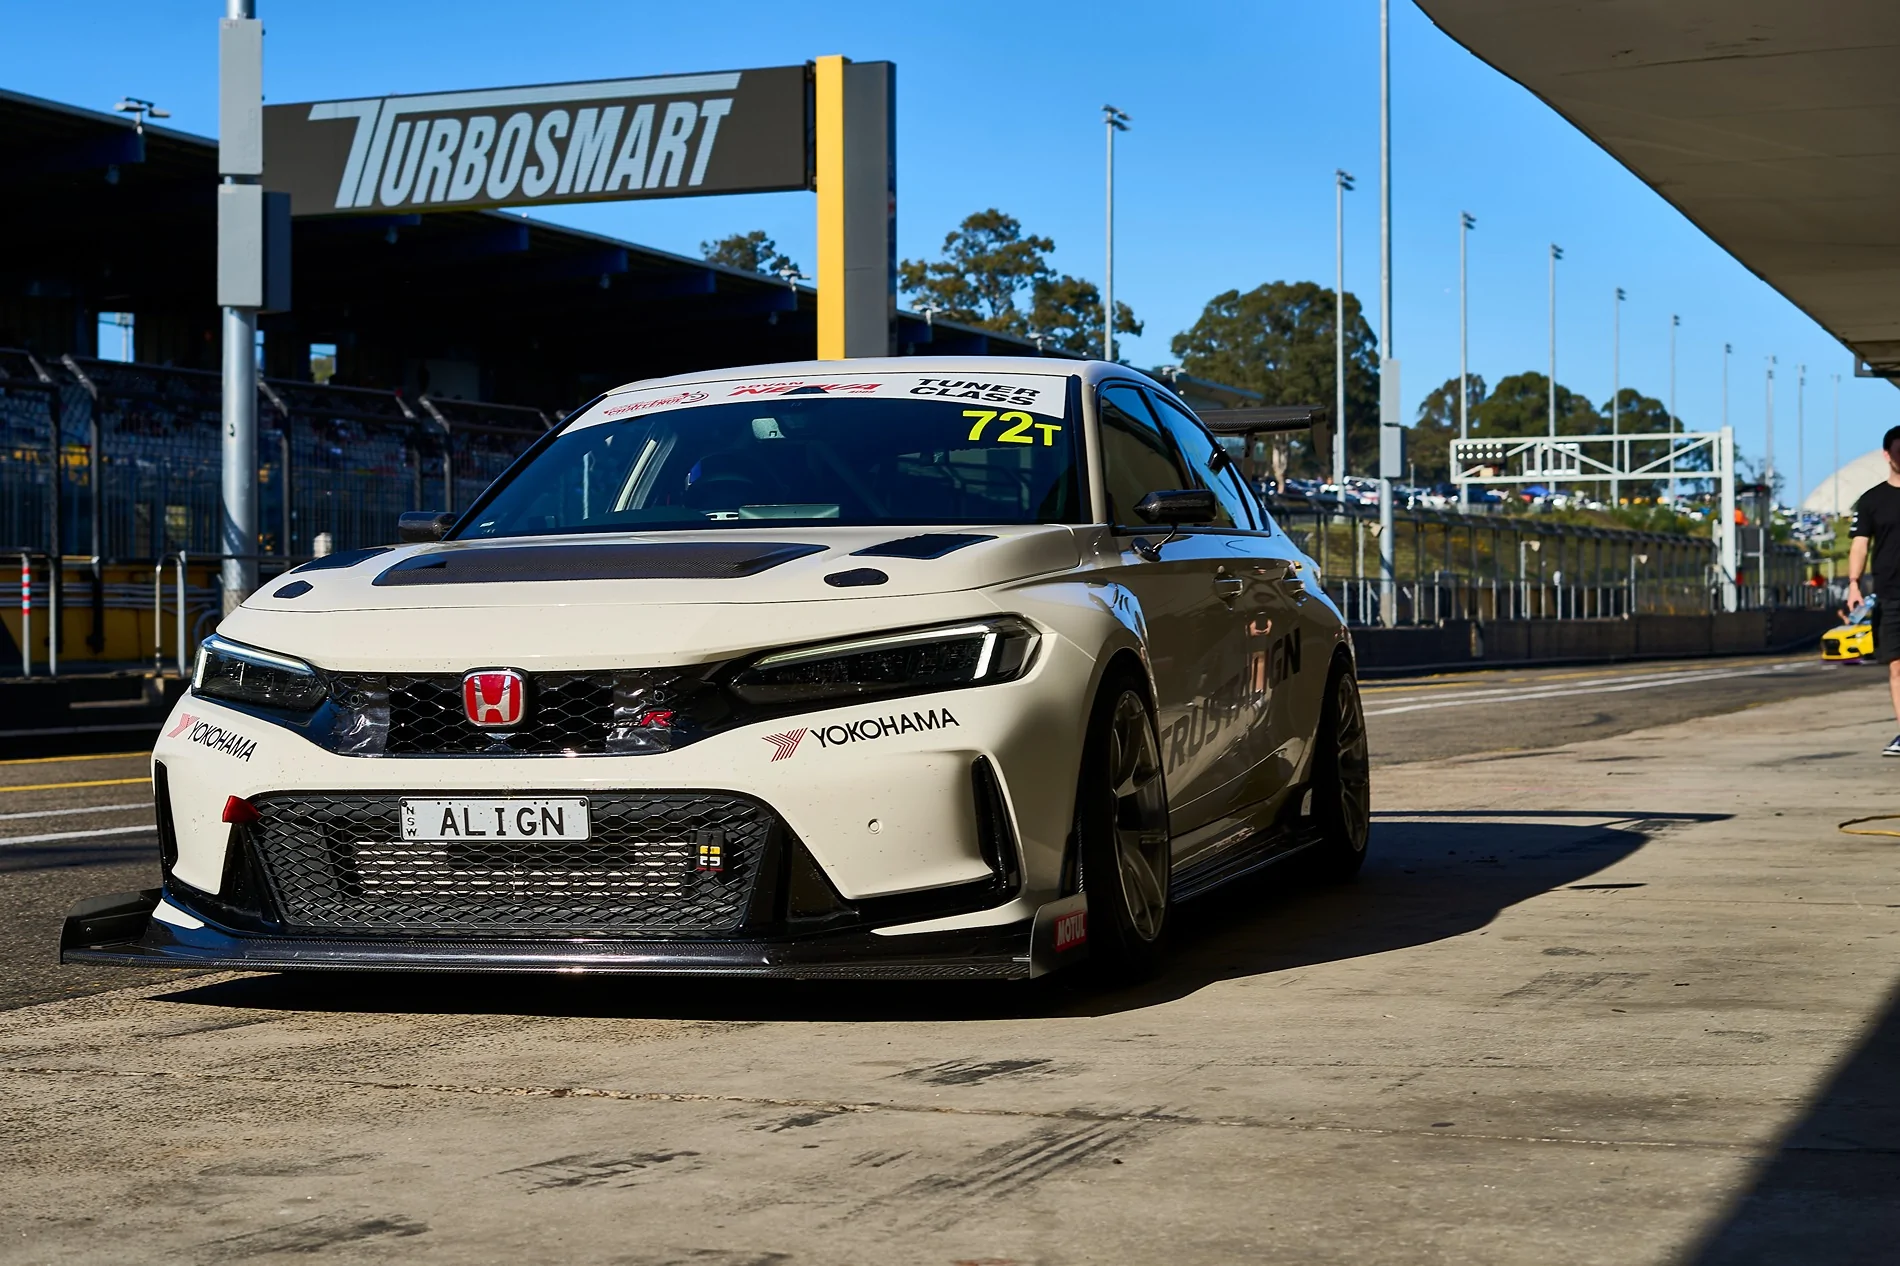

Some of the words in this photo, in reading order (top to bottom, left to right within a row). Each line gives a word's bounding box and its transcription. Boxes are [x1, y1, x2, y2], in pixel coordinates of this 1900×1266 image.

[308, 72, 742, 209] TURBOSMART
[909, 387, 1036, 406] CLASS
[918, 378, 1041, 397] TUNER
[962, 410, 1062, 446] 72T
[187, 720, 257, 762] YOKOHAMA
[810, 707, 960, 748] YOKOHAMA
[440, 807, 565, 836] ALIGN
[1057, 913, 1085, 946] MOTUL
